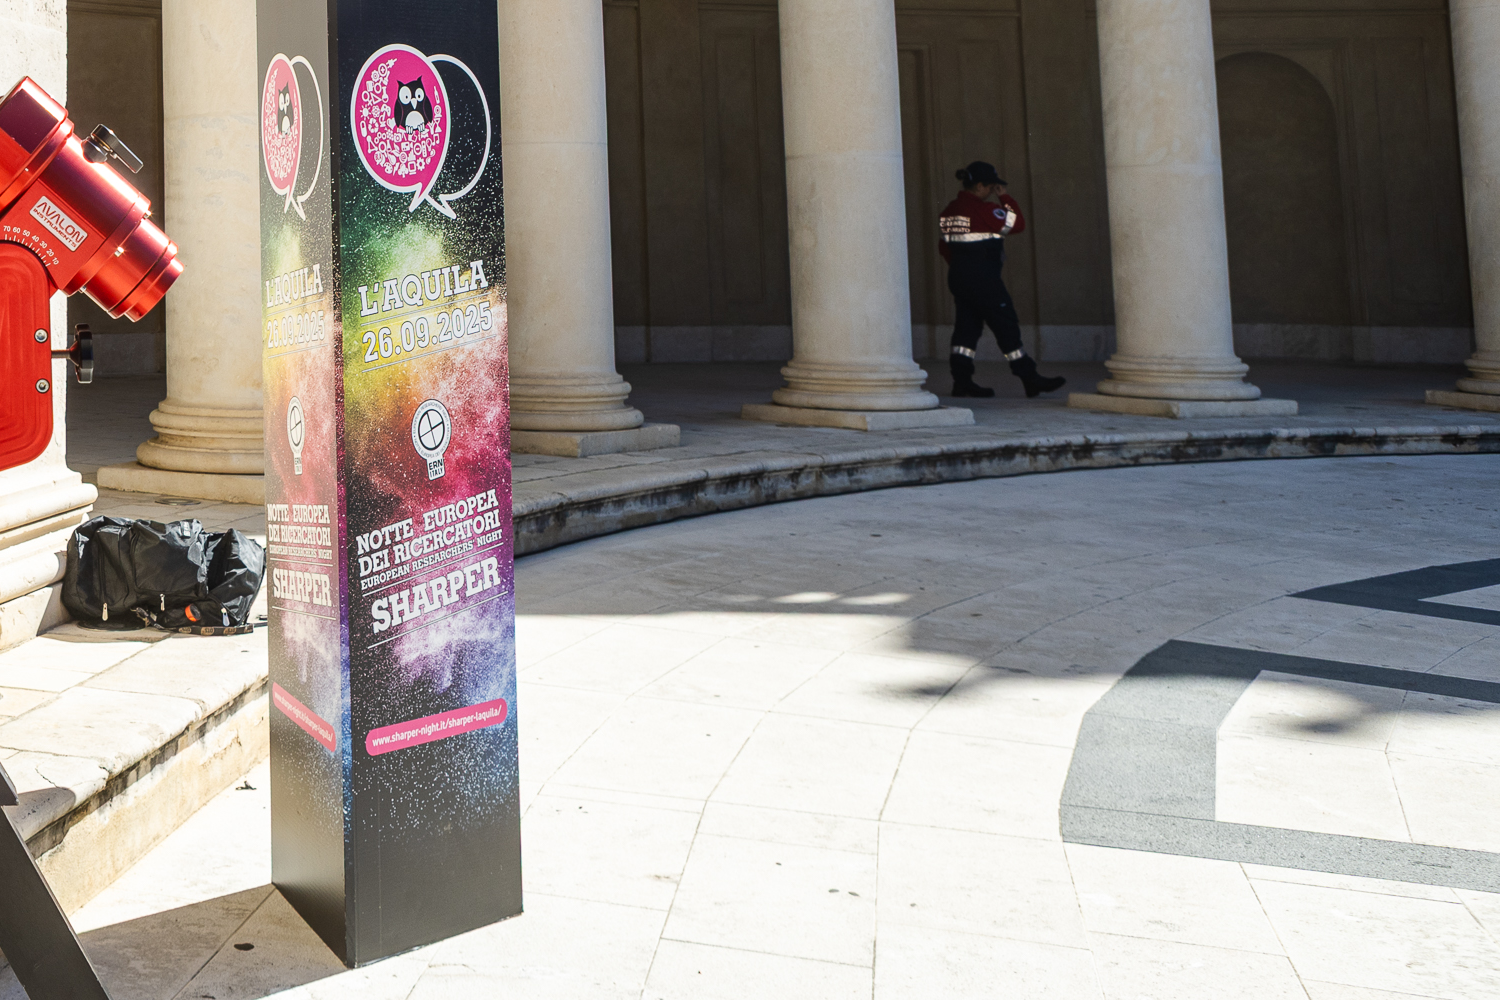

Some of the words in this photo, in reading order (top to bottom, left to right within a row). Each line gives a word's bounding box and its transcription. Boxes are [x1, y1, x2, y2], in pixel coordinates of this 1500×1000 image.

[32, 207, 77, 248] INSTRUMENTS
[36, 201, 85, 243] AVALON
[39, 241, 48, 249] 30
[46, 249, 55, 257] 20
[52, 257, 60, 265] 10
[266, 263, 323, 308] L'AQUILA
[358, 259, 489, 317] L'AQUILA
[266, 310, 325, 348] 26.09.2025
[362, 301, 493, 363] 26.09.2025
[428, 458, 443, 471] ERN
[430, 467, 443, 478] ITALY
[267, 503, 289, 522] NOTTE
[292, 504, 330, 524] EUROPEA
[356, 518, 414, 555] NOTTE
[422, 489, 499, 532] EUROPEA
[268, 524, 280, 542] DEI
[281, 525, 331, 546] RICERCATORI
[358, 549, 391, 577] DEI
[393, 509, 501, 564] RICERCATORI
[361, 564, 410, 590] EUROPEAN
[412, 540, 475, 572] RESEARCHERS'
[477, 529, 503, 547] NIGHT
[273, 568, 332, 607] SHARPER
[371, 556, 501, 634] SHARPER
[372, 704, 502, 747] www.sharper-night.it/sharper-laquila/
